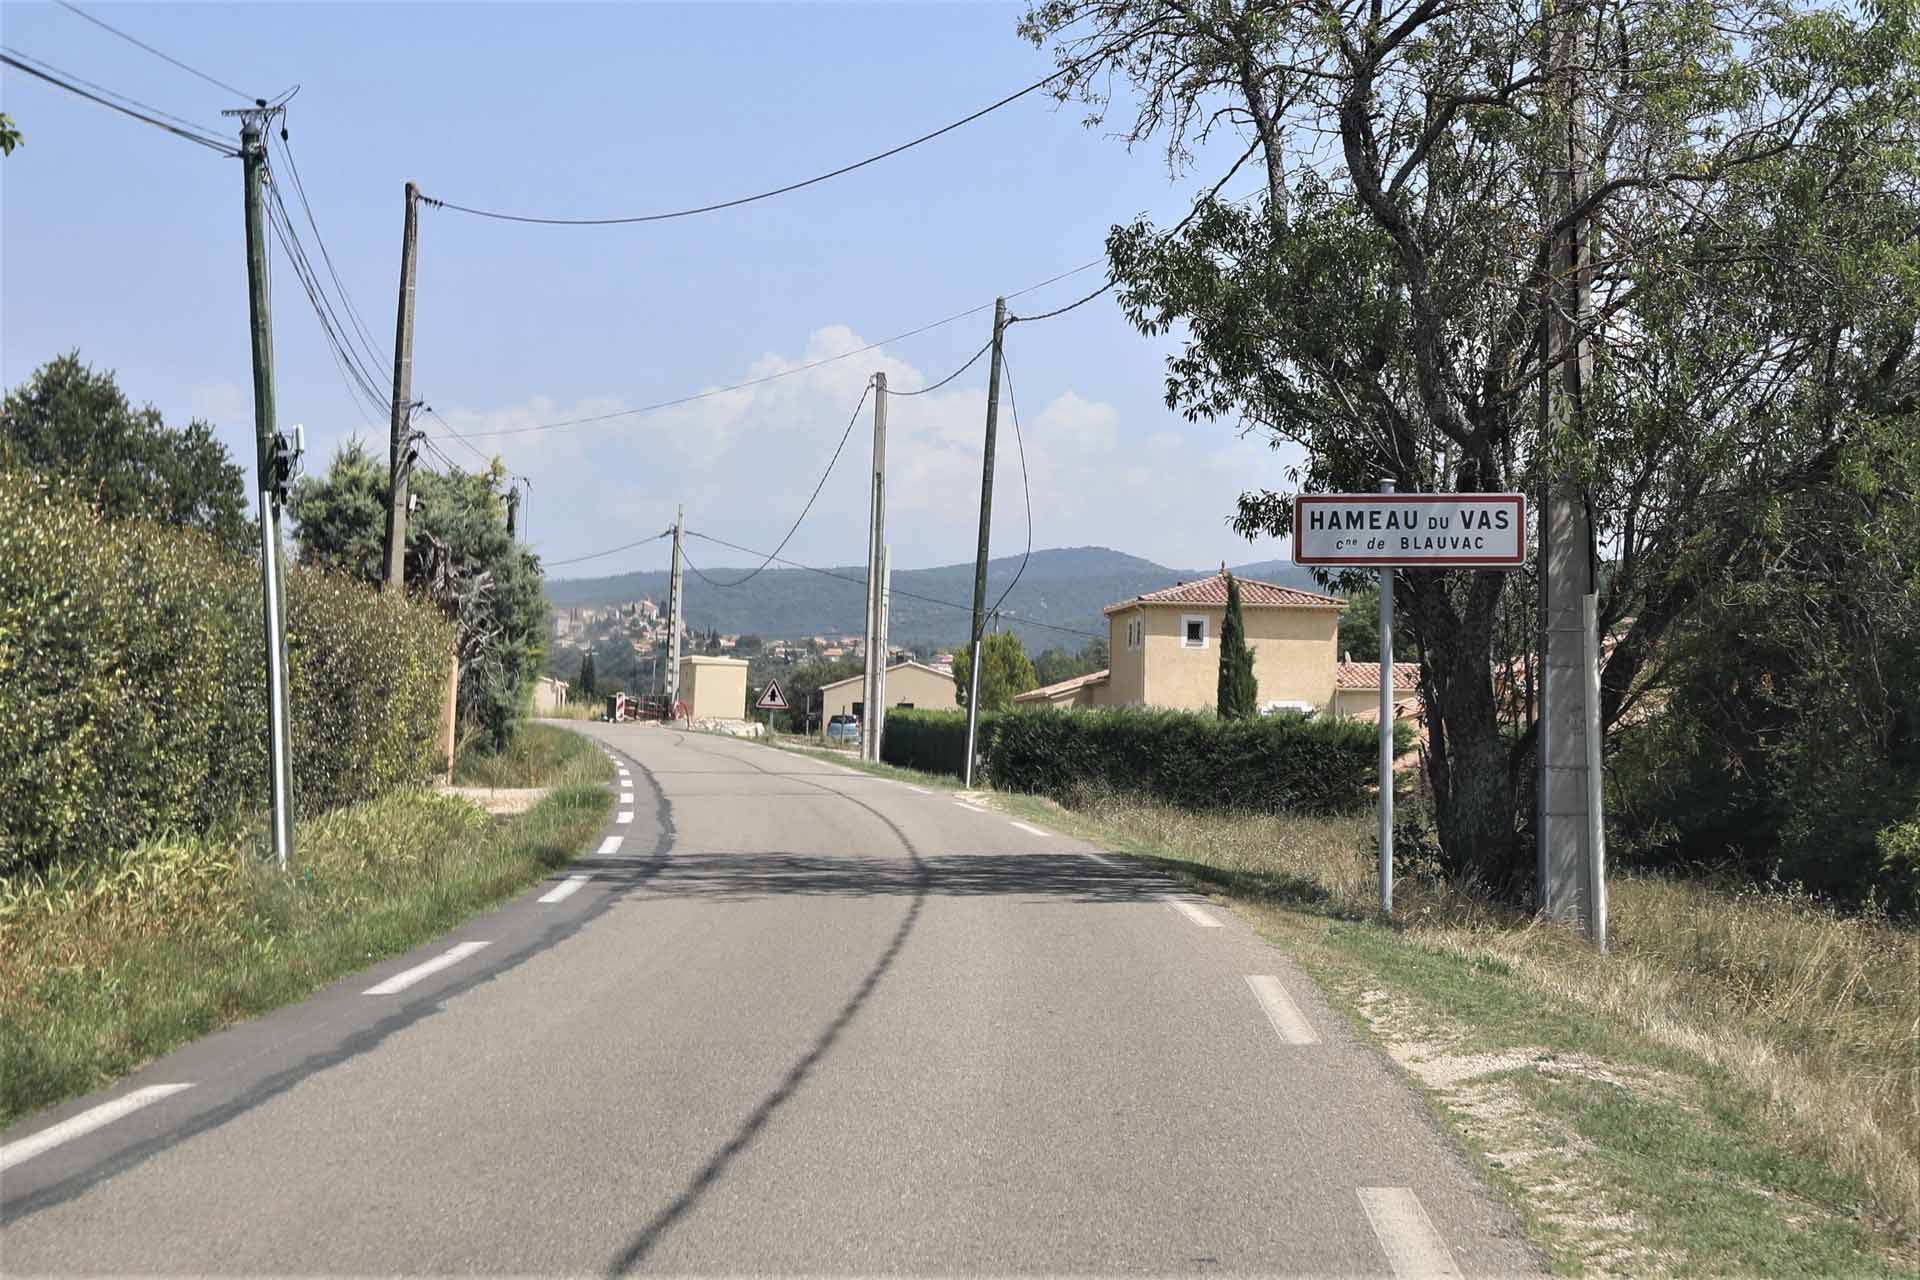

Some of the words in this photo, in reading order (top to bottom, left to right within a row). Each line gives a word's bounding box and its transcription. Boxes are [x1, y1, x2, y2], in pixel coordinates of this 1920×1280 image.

[1310, 510, 1418, 530] HAMEAU
[1428, 516, 1449, 530] DU
[1460, 510, 1509, 530] VAS
[1367, 536, 1385, 550] de
[1400, 537, 1484, 550] BLAUVAC
